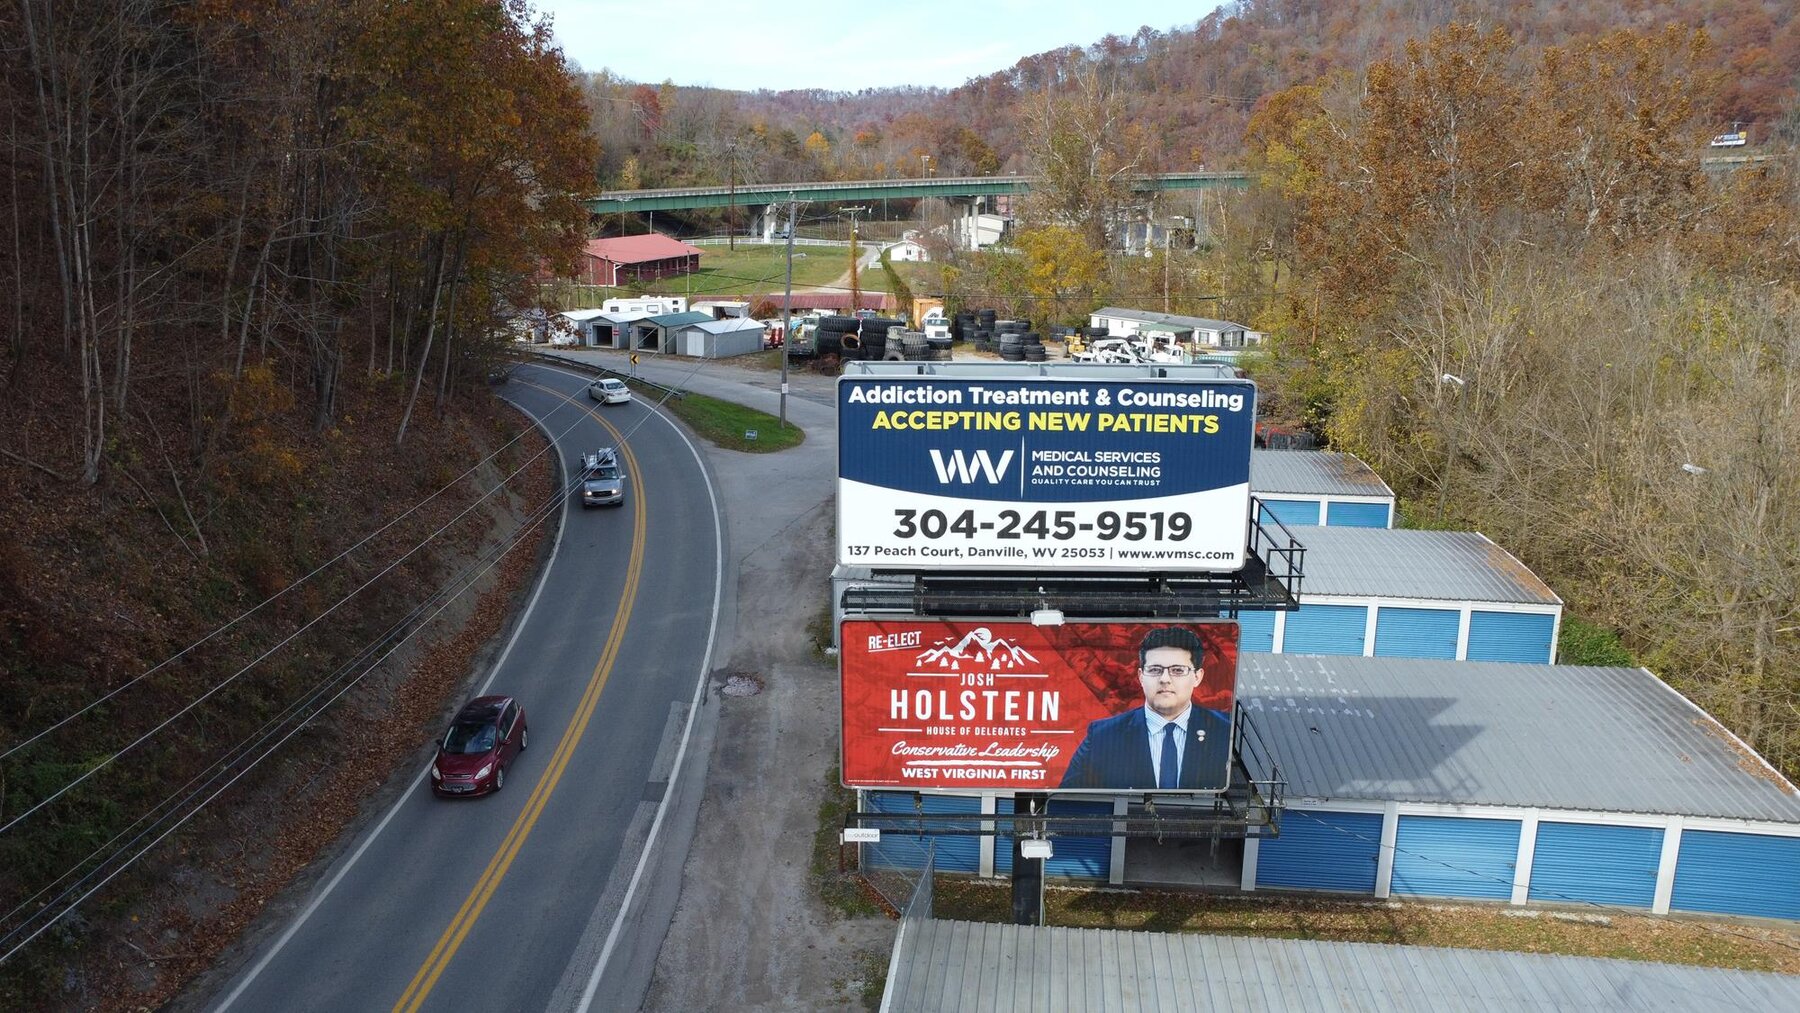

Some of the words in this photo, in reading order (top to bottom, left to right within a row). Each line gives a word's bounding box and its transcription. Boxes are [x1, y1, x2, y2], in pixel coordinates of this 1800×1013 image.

[848, 386, 962, 404] Addiction
[969, 387, 1089, 405] Treatment
[1095, 389, 1111, 405] &
[1118, 389, 1243, 411] Counseling
[872, 411, 1020, 430] ACCEPTING
[1029, 412, 1091, 431] NEW
[1099, 414, 1219, 433] PATIENTS
[1032, 451, 1092, 462] MEDICAL
[1095, 452, 1160, 463] SERVICES
[1032, 465, 1063, 476] AND
[1067, 466, 1160, 477] COUNSELING
[893, 509, 1192, 541] 304-245-9519
[848, 546, 870, 555] 137
[875, 546, 915, 556] Peach
[921, 547, 963, 558] Court,
[968, 547, 1027, 558] Danville,
[1033, 548, 1057, 557] WV
[1061, 548, 1104, 558] 25053
[1118, 551, 1234, 559] www.wvmsc.com
[869, 631, 921, 649] RE-ELECT
[961, 673, 993, 686] JOSH
[891, 690, 1059, 721] HOLSTEIN
[927, 727, 955, 735] HOUSE
[960, 727, 970, 735] OF
[975, 727, 1026, 736] DELEGATES
[892, 741, 977, 756] Conservative
[979, 742, 1059, 761] Leadership
[902, 768, 938, 778] WEST
[942, 769, 1006, 779] VIRGINIA
[1011, 770, 1046, 779] FIRST
